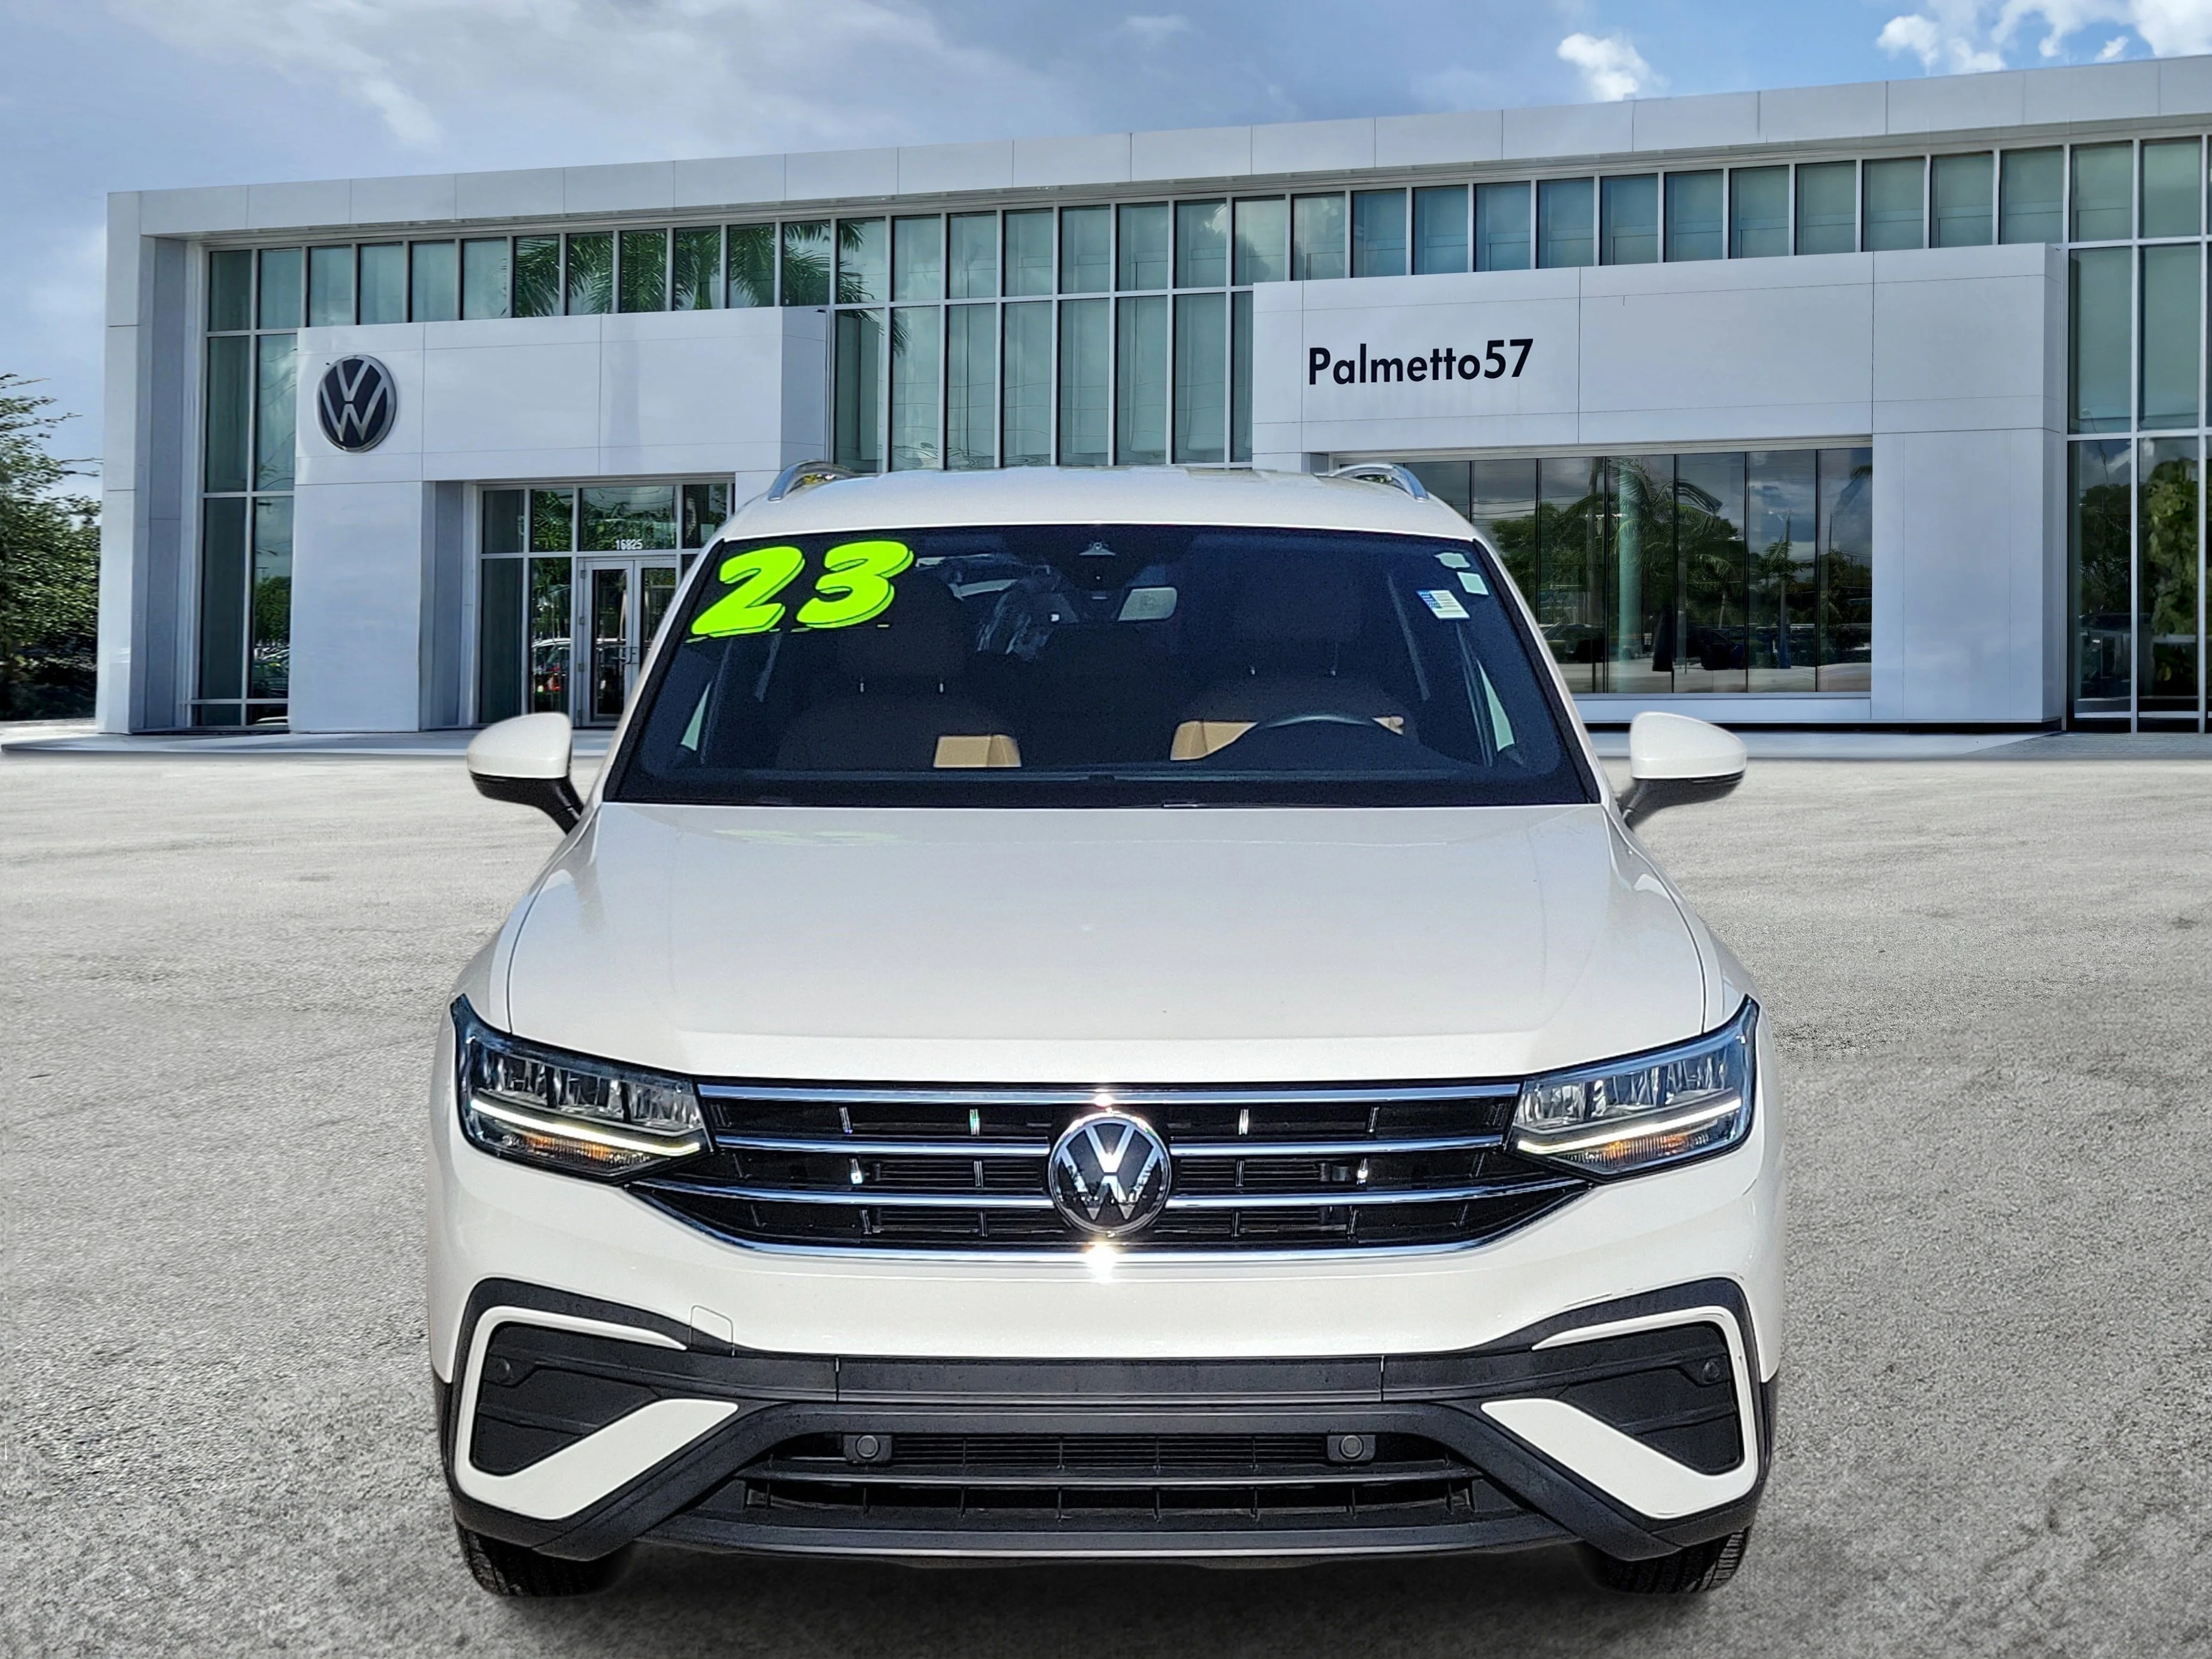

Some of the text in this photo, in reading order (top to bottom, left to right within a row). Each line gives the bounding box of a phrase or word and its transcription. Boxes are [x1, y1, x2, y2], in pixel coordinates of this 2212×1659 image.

[1309, 338, 1534, 385] Palmetto57
[318, 356, 392, 447] VW
[615, 539, 643, 550] 16825
[691, 540, 914, 638] 23
